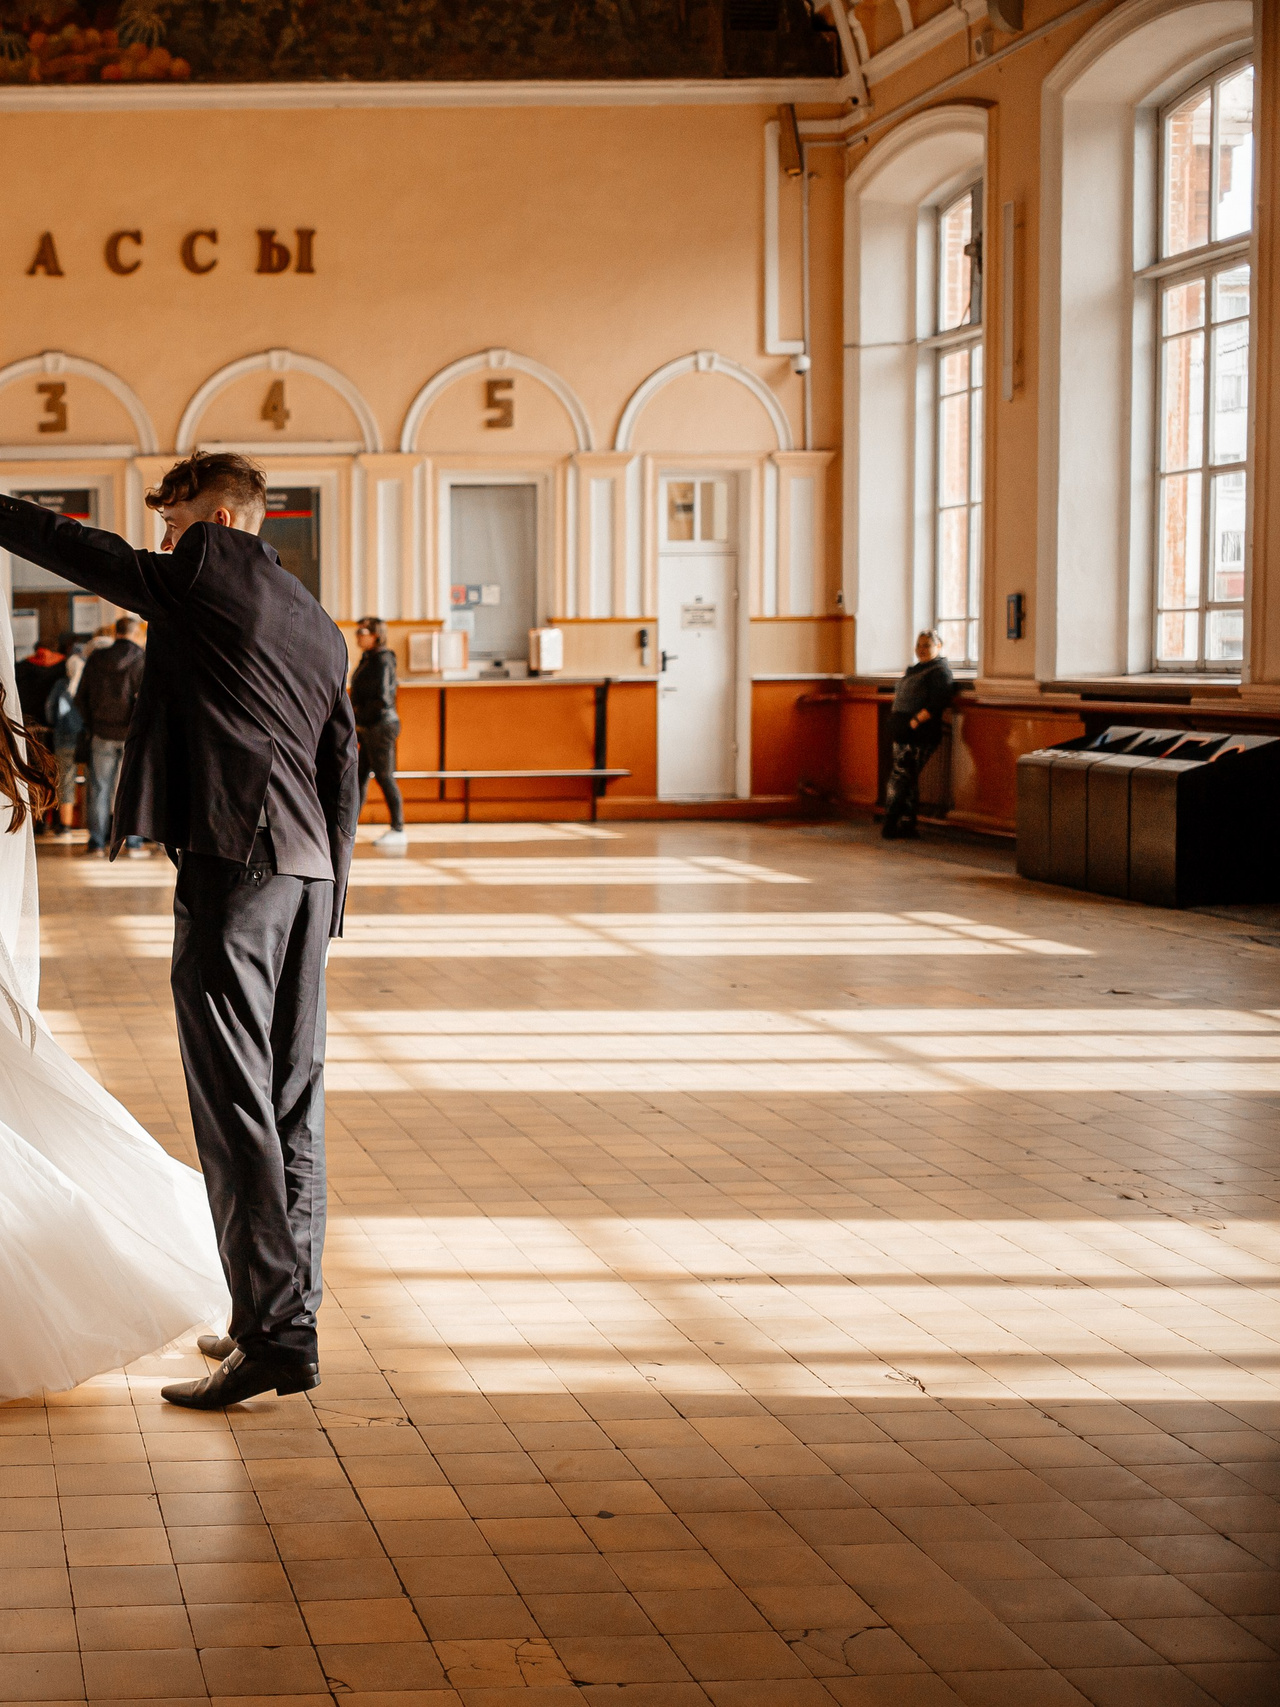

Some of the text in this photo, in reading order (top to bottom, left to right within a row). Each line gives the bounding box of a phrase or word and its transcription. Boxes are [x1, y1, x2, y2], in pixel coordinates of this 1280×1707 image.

[36, 382, 68, 433] 3
[260, 380, 290, 430] 4
[485, 379, 514, 428] 5
